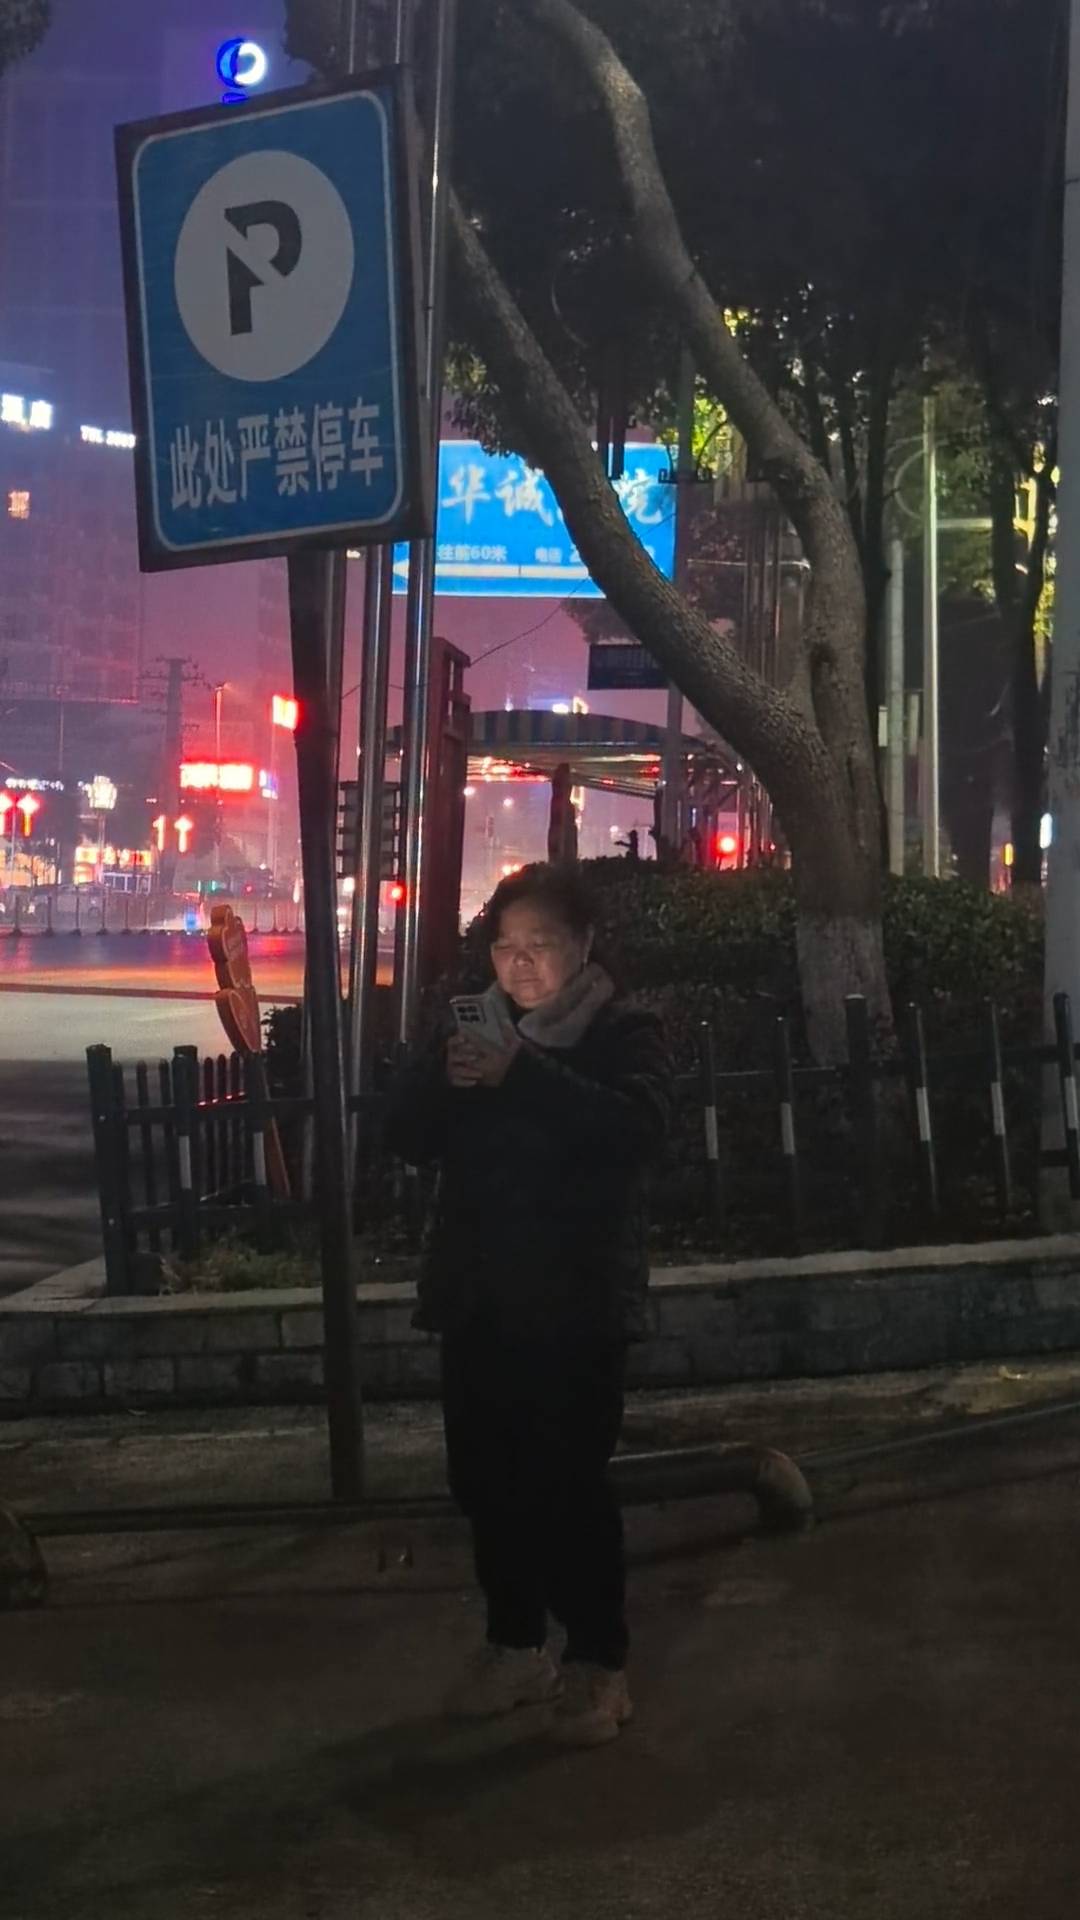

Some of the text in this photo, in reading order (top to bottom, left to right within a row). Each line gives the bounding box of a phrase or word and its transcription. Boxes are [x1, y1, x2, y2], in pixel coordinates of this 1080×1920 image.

[224, 200, 302, 336] P
[170, 397, 384, 511] 此处严禁停车
